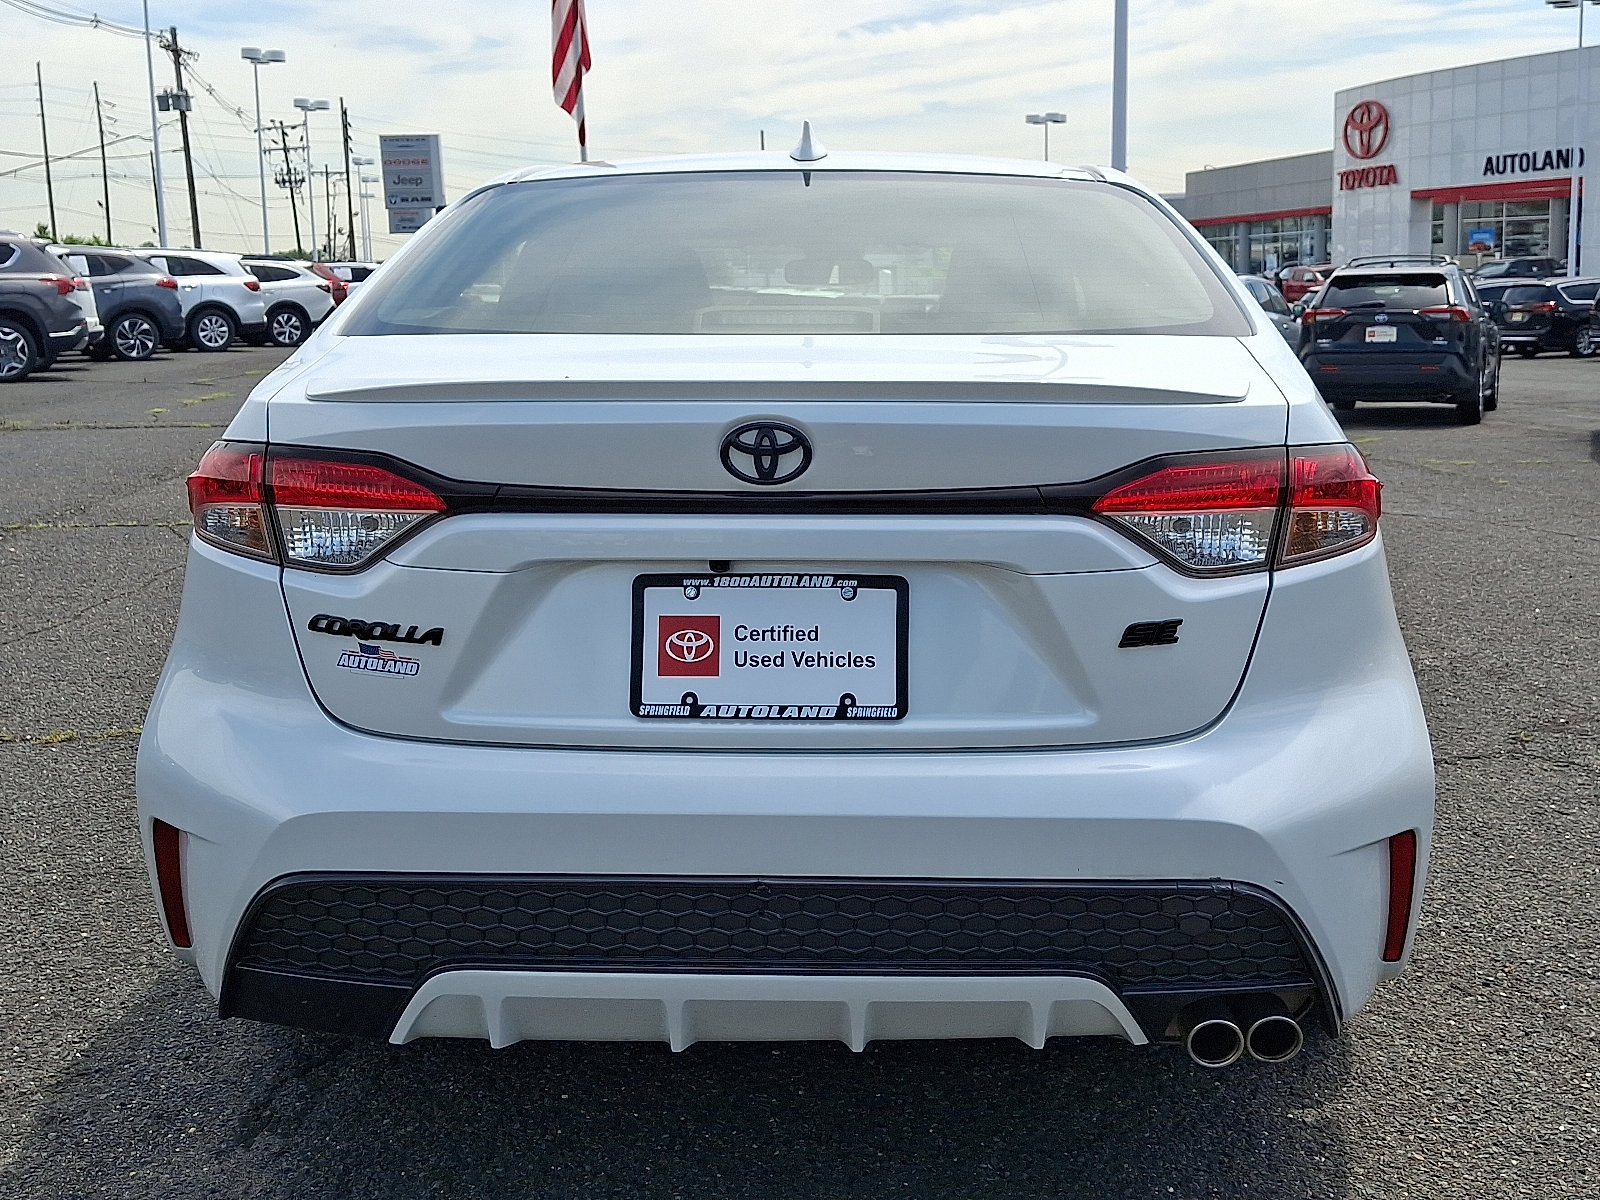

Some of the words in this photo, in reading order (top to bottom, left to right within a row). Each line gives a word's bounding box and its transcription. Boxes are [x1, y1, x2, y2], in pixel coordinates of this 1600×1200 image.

[393, 175, 423, 187] Jeep
[1338, 164, 1398, 191] TOYOTA
[308, 613, 445, 646] COROLLA
[734, 625, 819, 642] Certified
[1118, 618, 1184, 648] SE
[338, 654, 418, 675] AUTOLAND
[734, 651, 785, 668] Used
[792, 651, 876, 668] Vehicles
[639, 705, 690, 716] SPRINGFIELD
[700, 705, 837, 718] AUTOLAND
[847, 706, 898, 718] SPRINGFIELD
